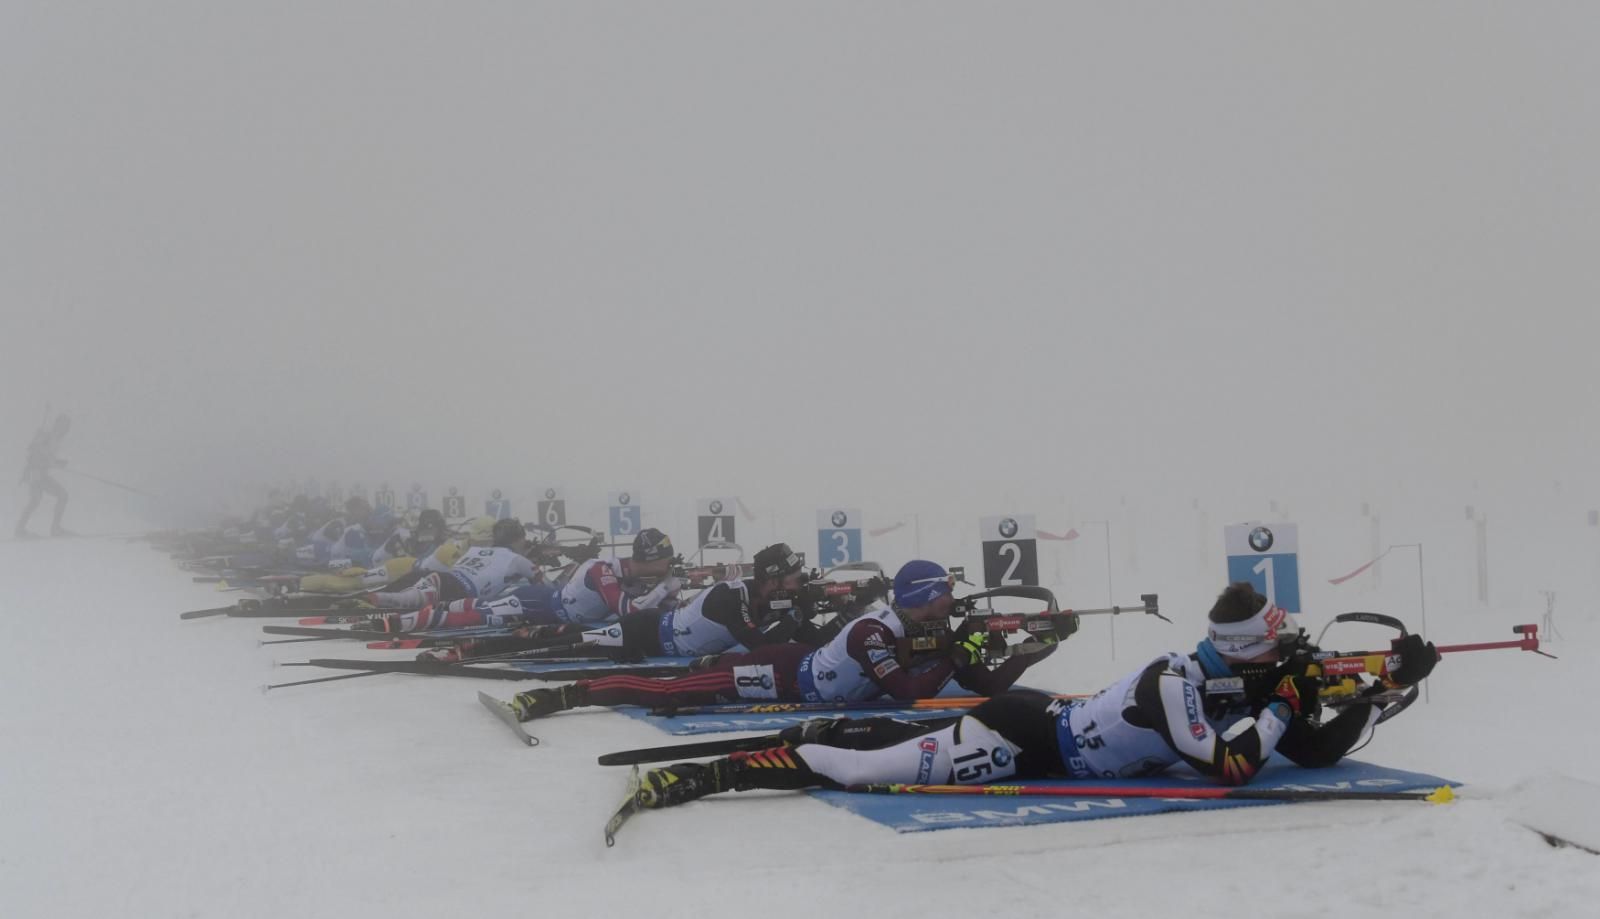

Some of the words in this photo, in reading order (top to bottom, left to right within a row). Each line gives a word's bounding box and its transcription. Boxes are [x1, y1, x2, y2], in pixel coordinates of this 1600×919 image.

[448, 498, 459, 517] 8
[492, 502, 503, 521] 7
[546, 502, 558, 526] 6
[618, 508, 632, 534] 5
[707, 517, 726, 542] 4
[831, 531, 850, 567] 3
[999, 542, 1022, 586] 2
[1252, 557, 1276, 605] 1
[737, 676, 761, 688] 8
[1184, 684, 1198, 724] LAPUA
[1083, 720, 1106, 750] 15
[953, 747, 992, 782] 15
[912, 797, 1128, 824] BMW
